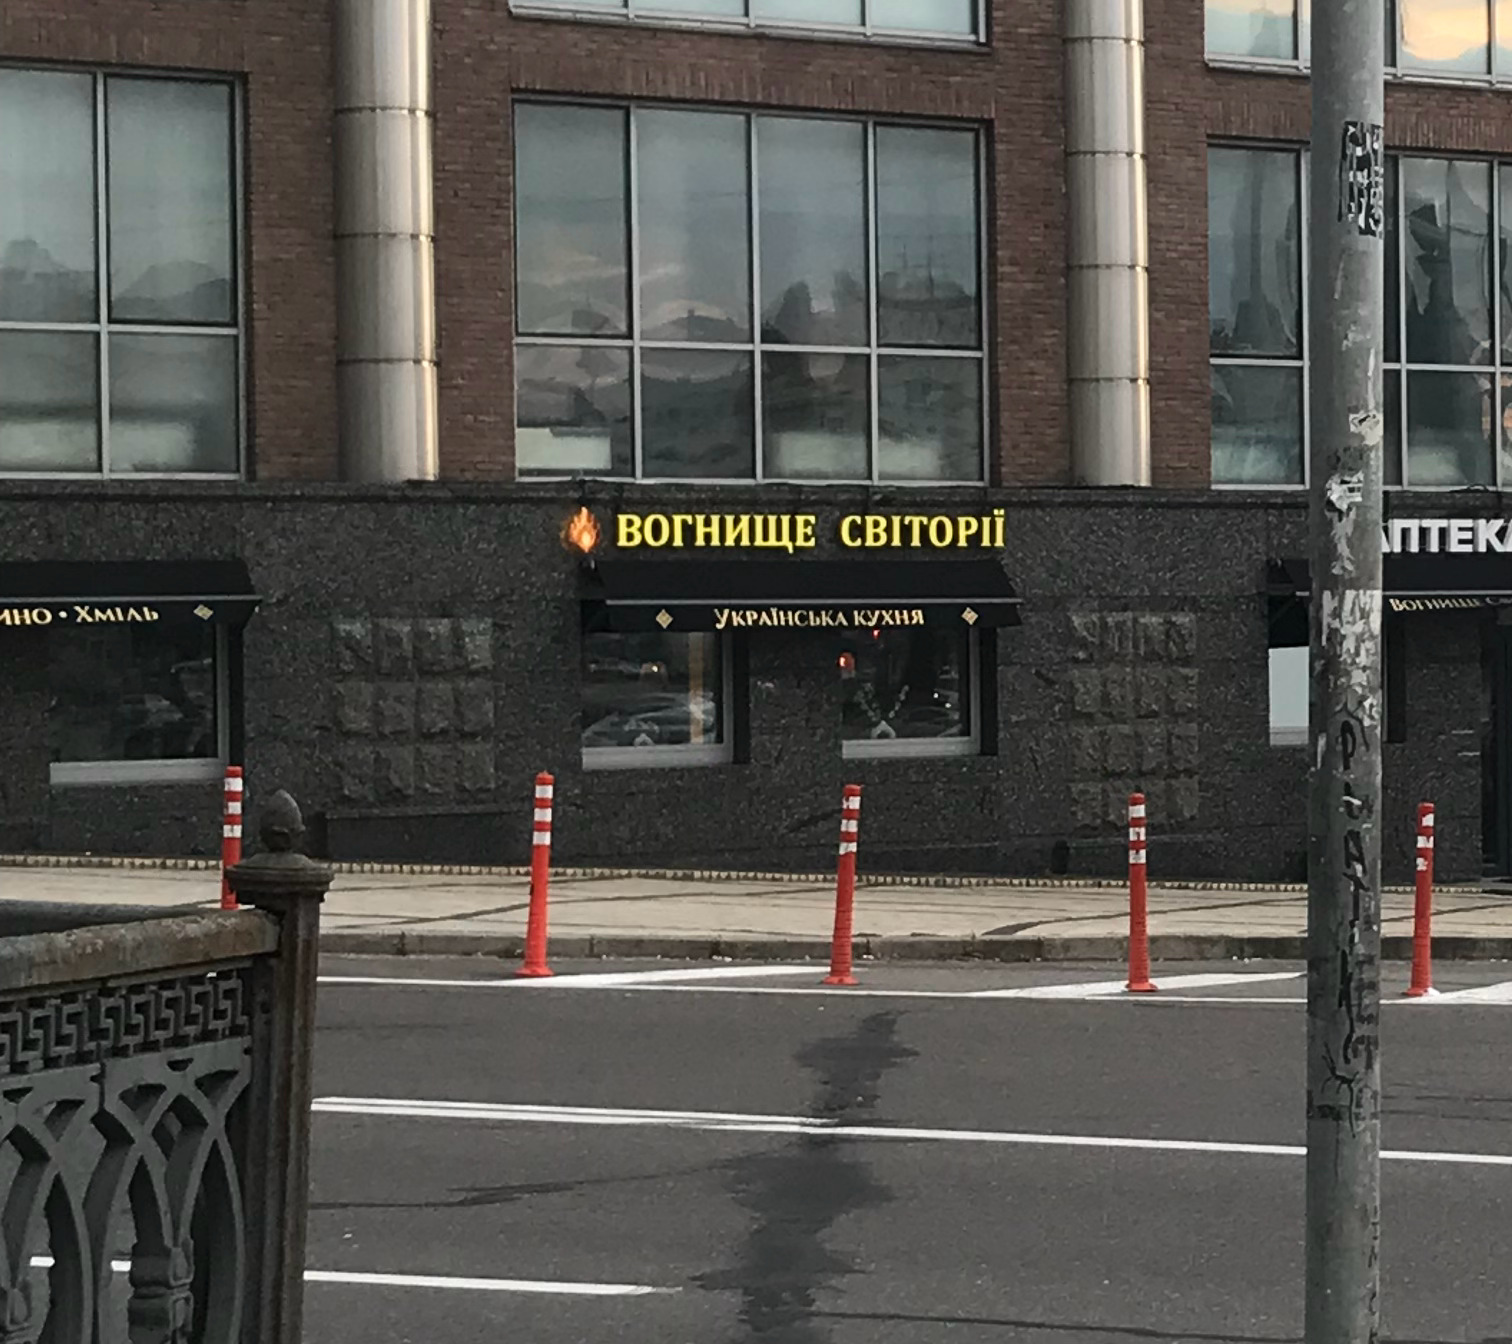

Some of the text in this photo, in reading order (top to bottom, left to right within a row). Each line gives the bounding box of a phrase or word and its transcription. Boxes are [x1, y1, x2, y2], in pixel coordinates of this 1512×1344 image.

[616, 509, 1006, 554] ВОГНИЩЕ СВІТОРІЇ
[714, 607, 925, 630] УКРАЇНСЬКА КУХНЯ
